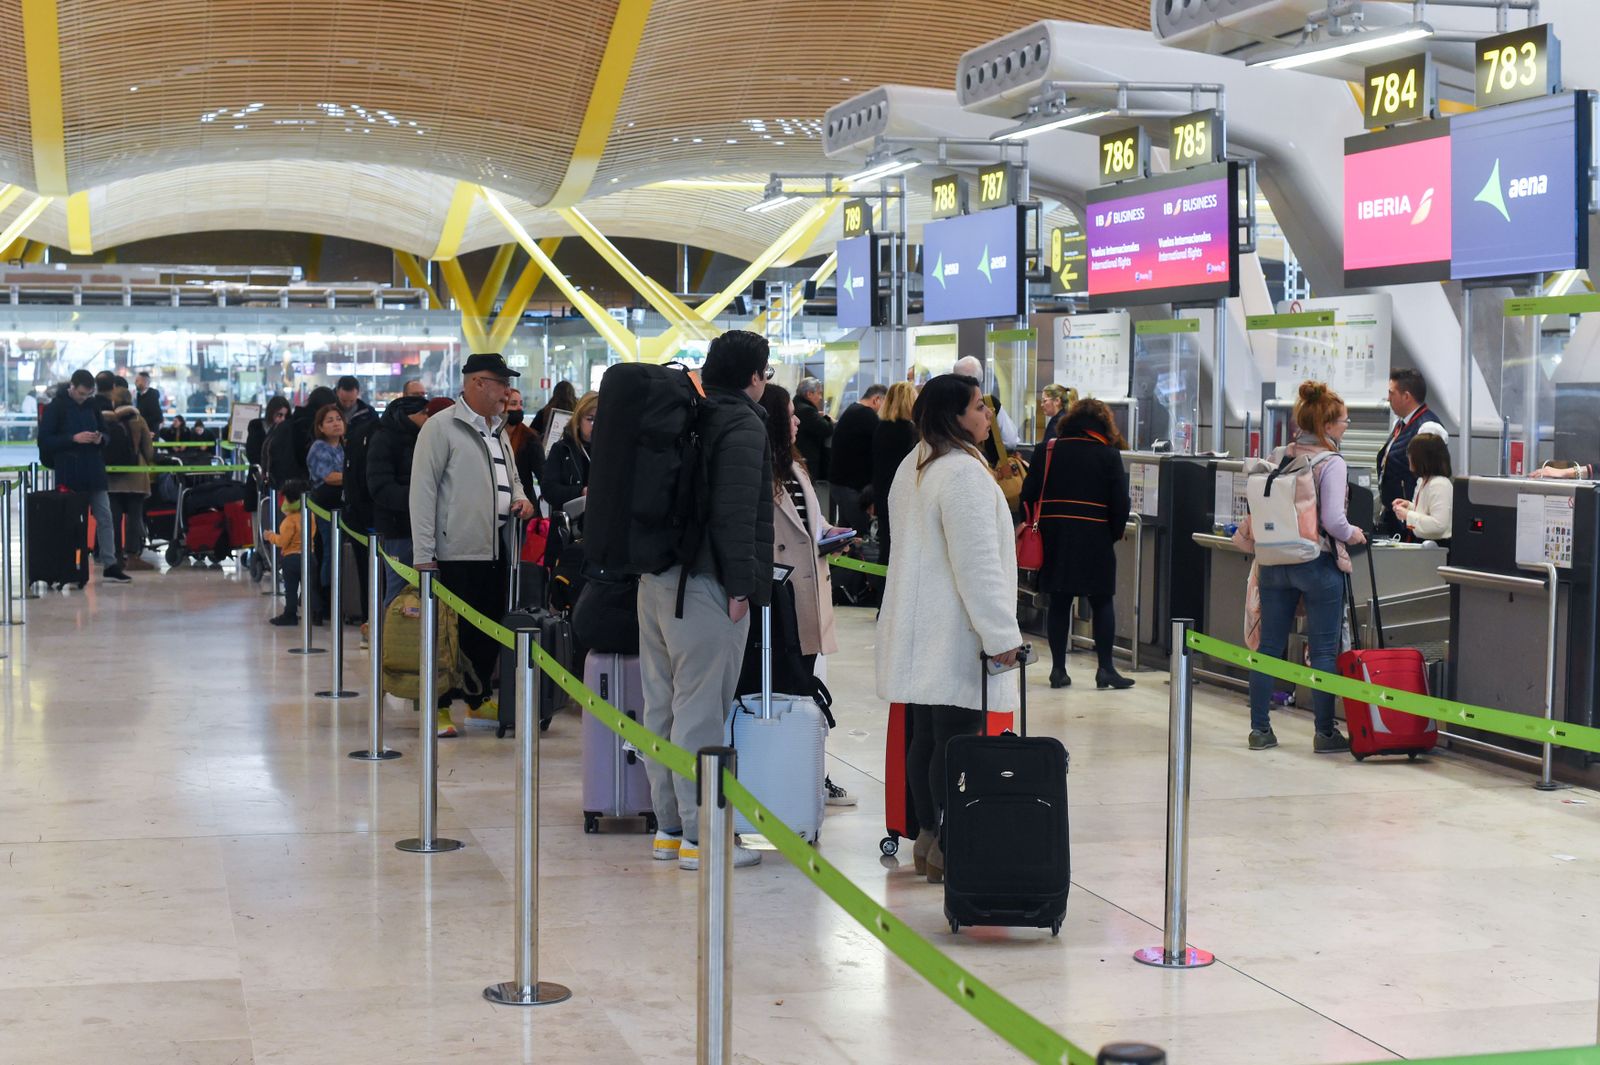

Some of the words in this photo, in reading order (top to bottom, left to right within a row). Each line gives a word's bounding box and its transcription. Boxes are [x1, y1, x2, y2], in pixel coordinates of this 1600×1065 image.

[1484, 42, 1536, 93] 783
[1370, 69, 1417, 116] 784
[1174, 121, 1206, 160] 785
[1103, 138, 1134, 175] 786
[934, 183, 955, 212] 788
[981, 171, 1004, 202] 787
[1508, 174, 1548, 198] aena
[845, 207, 861, 231] 789
[1095, 214, 1105, 227] IB
[1113, 208, 1145, 224] BUSINESS
[1163, 202, 1173, 215] IB
[1182, 194, 1217, 212] BUSINESS
[1358, 195, 1412, 220] IBERIA
